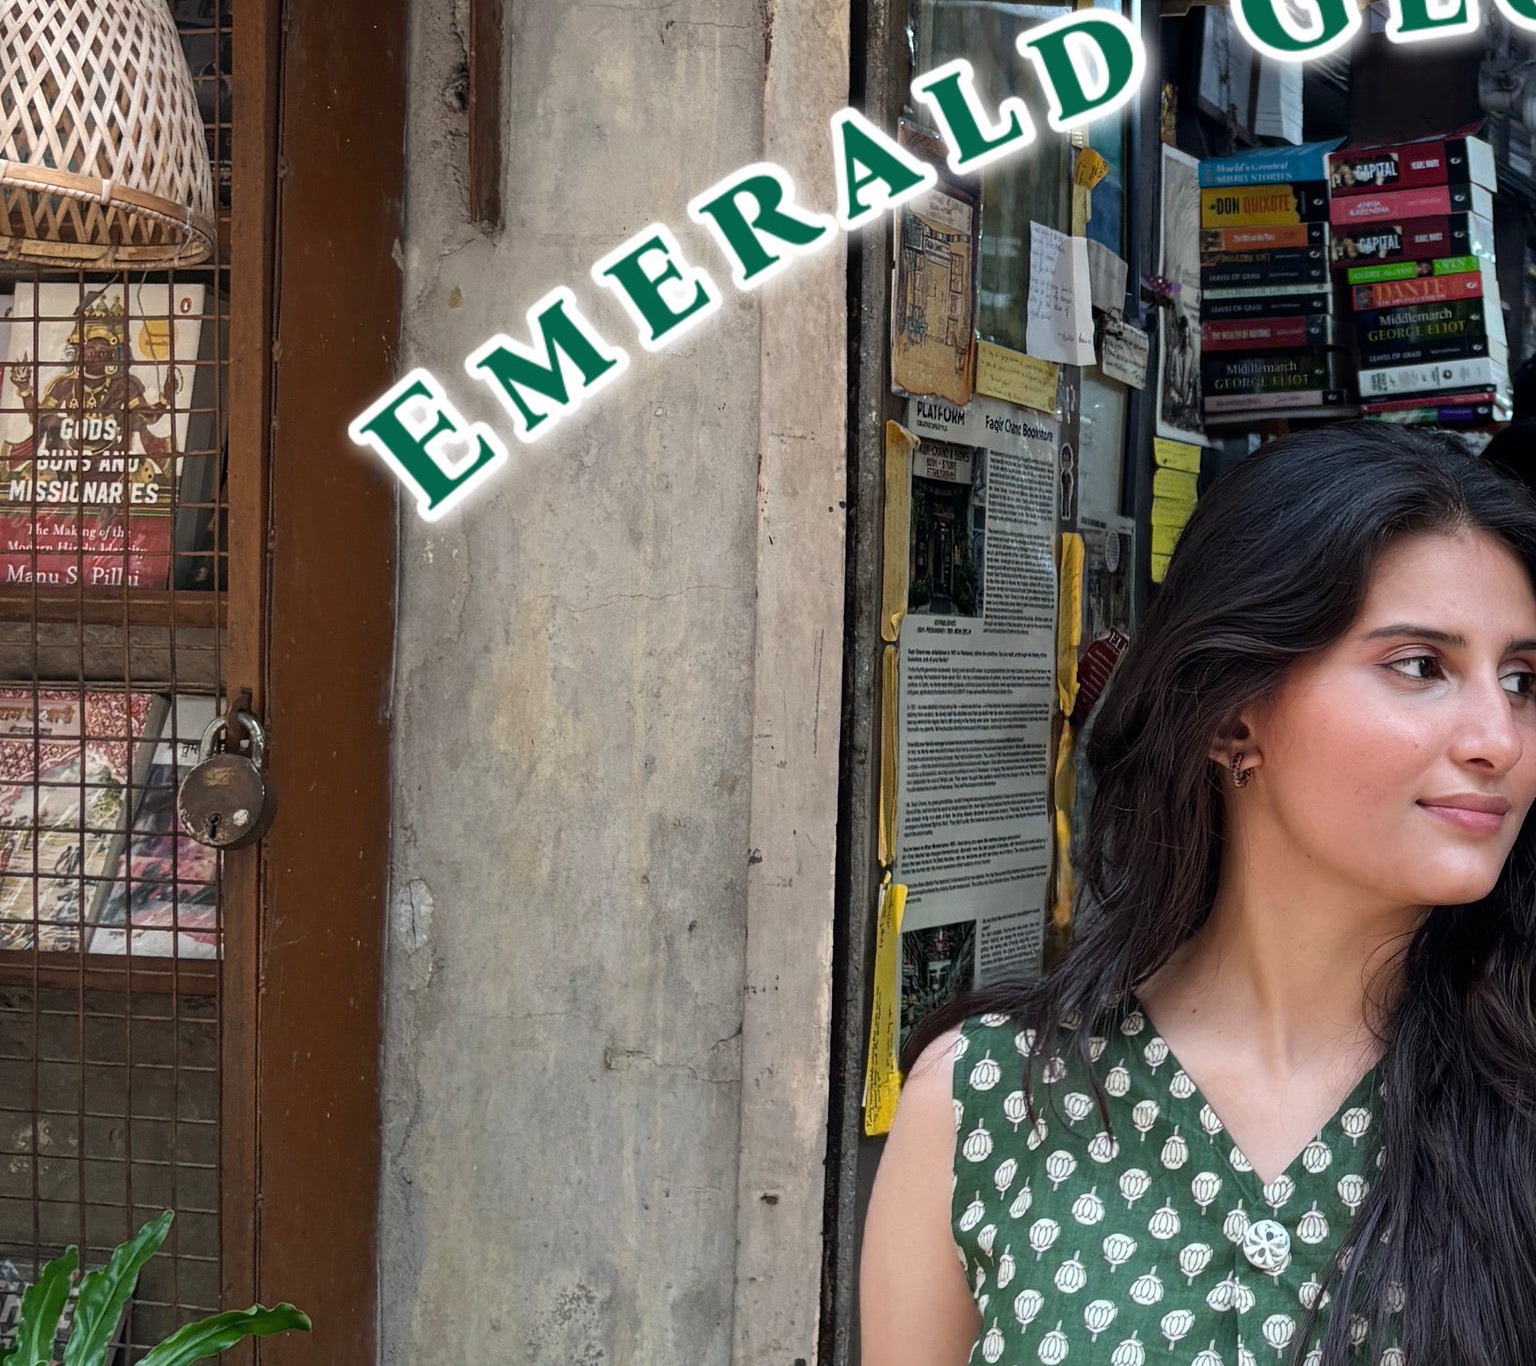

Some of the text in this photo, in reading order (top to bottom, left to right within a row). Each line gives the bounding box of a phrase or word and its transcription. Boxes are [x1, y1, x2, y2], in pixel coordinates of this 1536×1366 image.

[1355, 160, 1399, 182] CAPITAL
[1216, 194, 1292, 215] DON QUIXOTE
[1358, 234, 1401, 255] CAPITAL
[1375, 278, 1445, 301] DANTE
[1379, 307, 1453, 327] Middlemarch
[1367, 319, 1466, 343] GEORGE ELIOT
[1225, 360, 1298, 376] Middlemarch
[916, 400, 966, 426] PLATFORM
[8, 479, 160, 504] MISSIONARES
[53, 522, 97, 538] Makng
[112, 525, 131, 537] th
